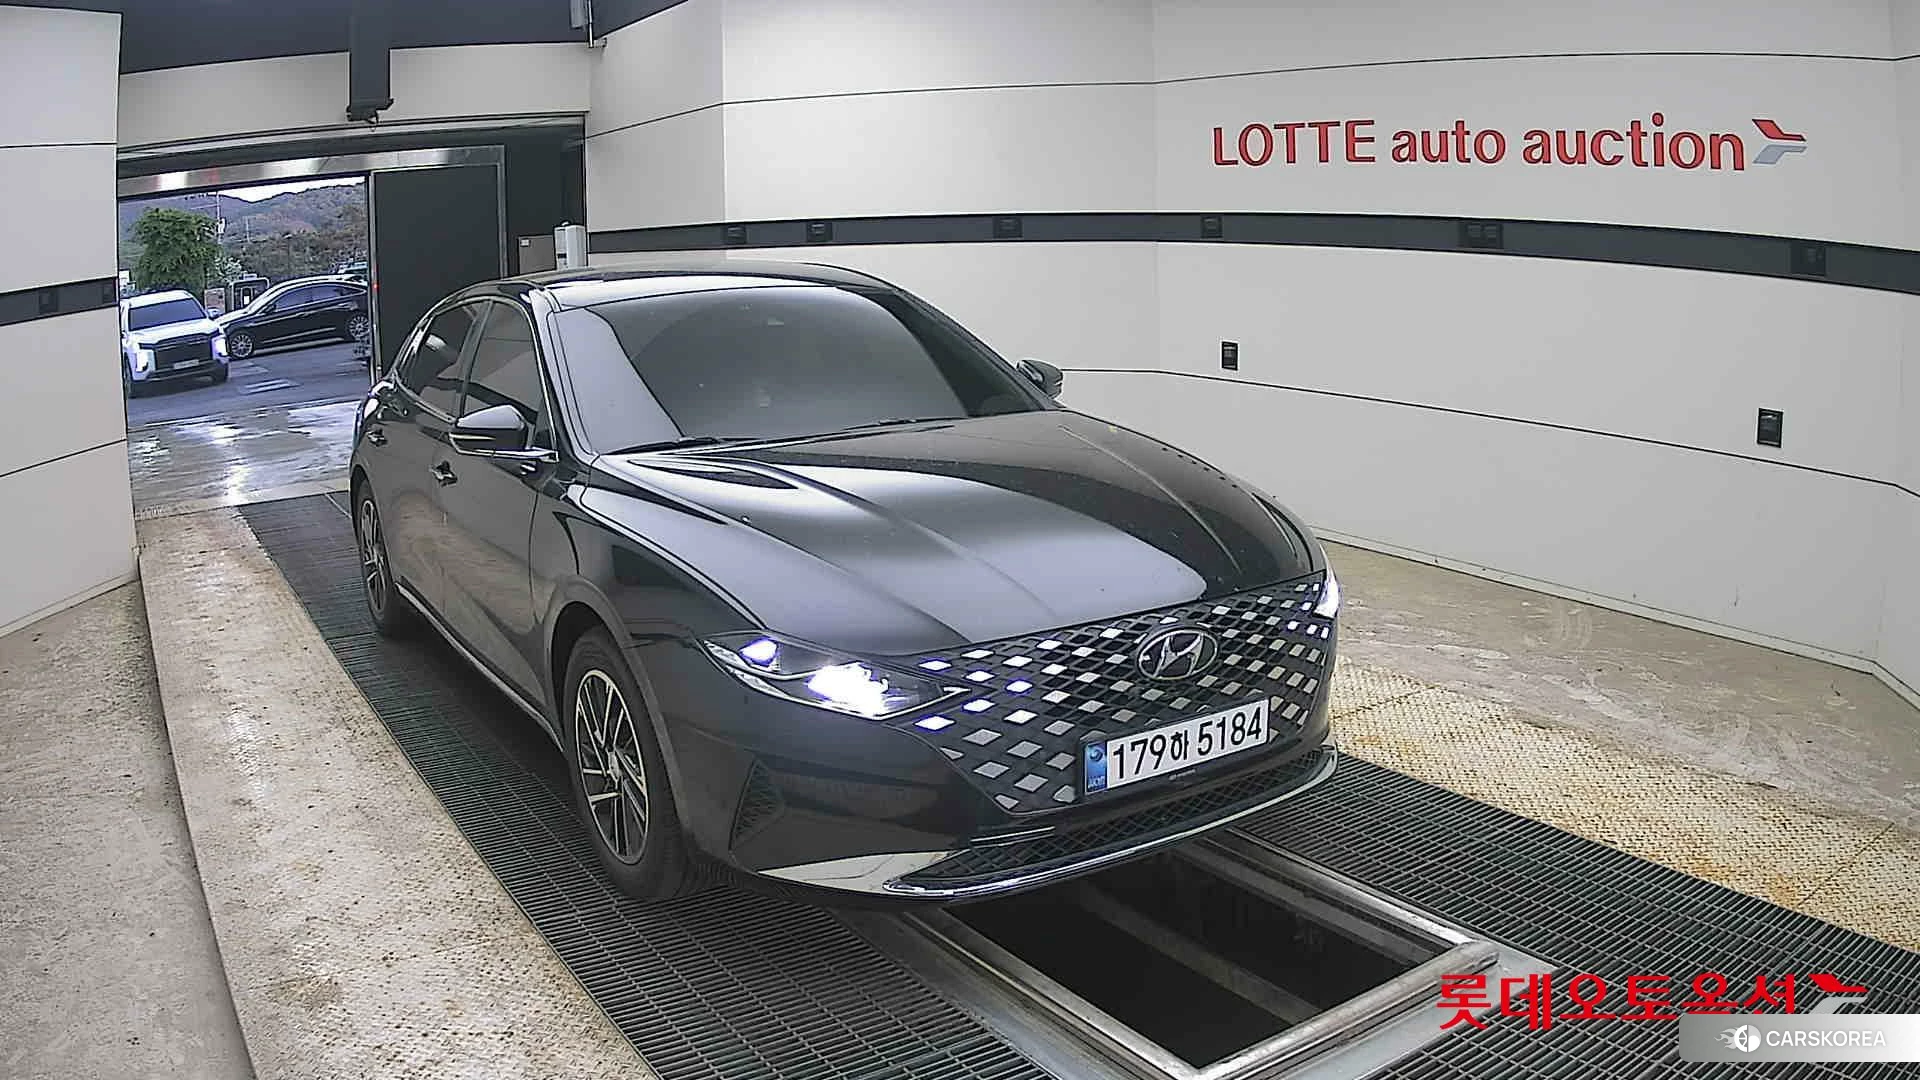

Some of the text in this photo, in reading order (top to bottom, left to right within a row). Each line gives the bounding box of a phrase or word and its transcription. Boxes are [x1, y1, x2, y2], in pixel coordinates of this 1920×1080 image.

[1212, 111, 1746, 171] LOTTE auto auction
[1113, 706, 1263, 780] 179하 5184
